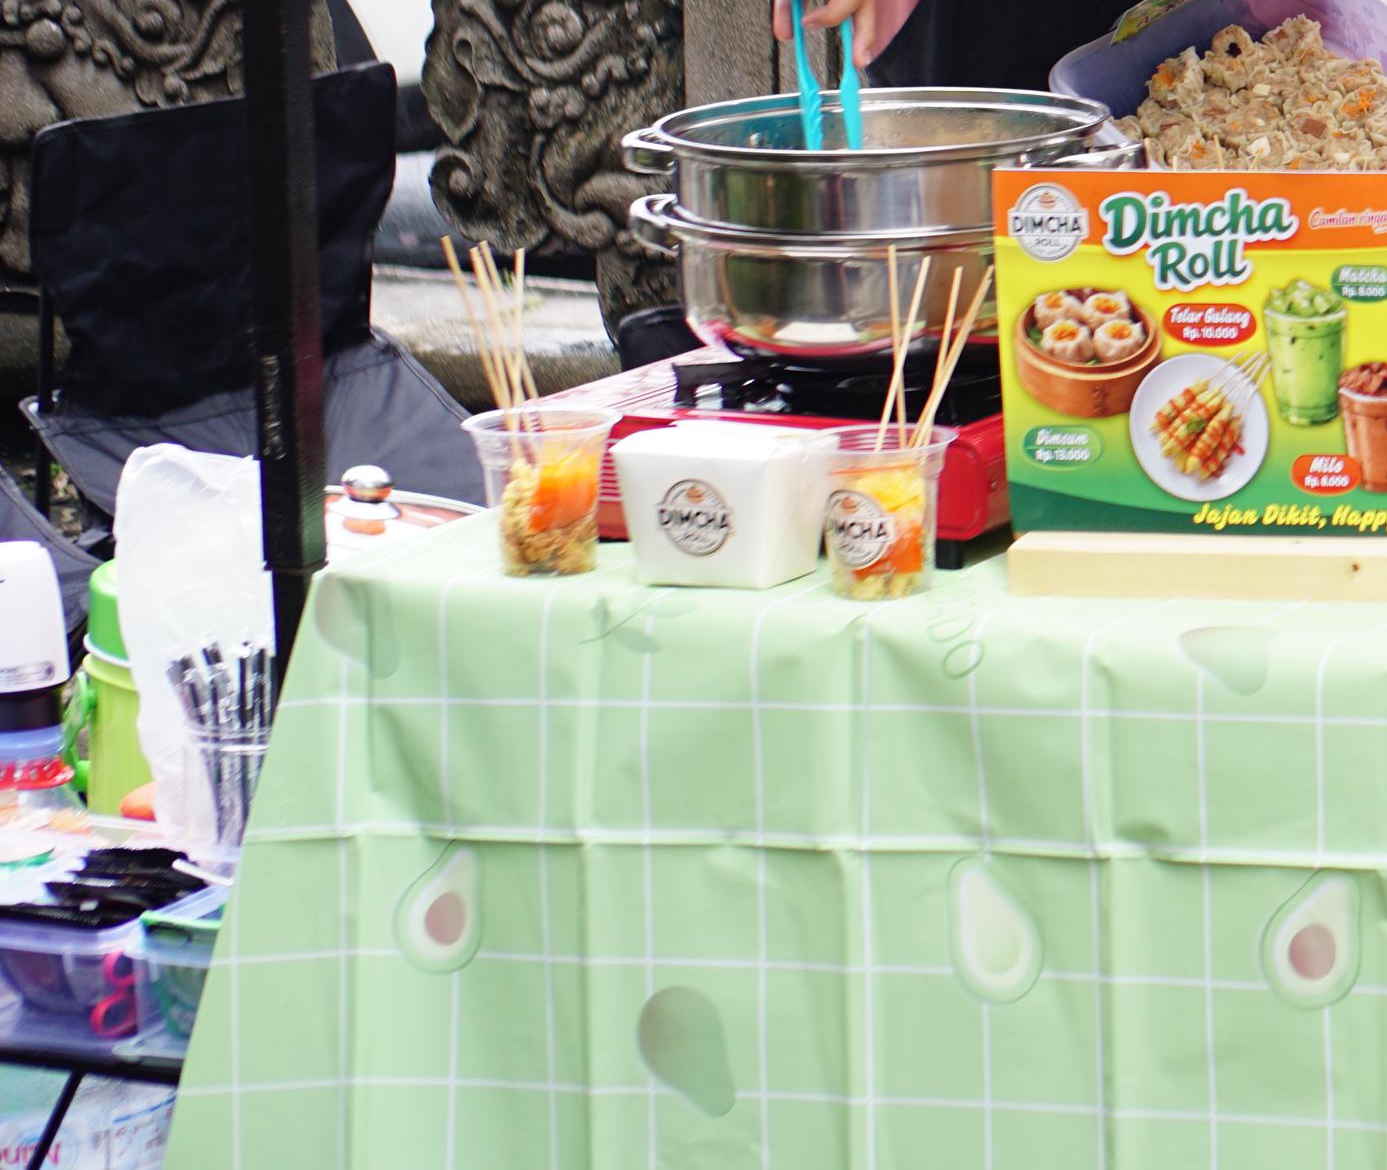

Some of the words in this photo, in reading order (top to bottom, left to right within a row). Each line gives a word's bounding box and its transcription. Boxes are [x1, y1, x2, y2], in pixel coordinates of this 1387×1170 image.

[1013, 216, 1081, 233] DIMCHA
[1104, 192, 1294, 248] Dimcha
[1310, 208, 1357, 228] Camilan
[1151, 239, 1247, 285] Roll
[1339, 266, 1387, 283] Matcha
[1201, 326, 1239, 339] 10.000
[1309, 456, 1345, 474] Milo
[658, 509, 730, 531] DIMCHA
[1193, 503, 1259, 530] Jajan
[1262, 504, 1327, 529] Dikit,
